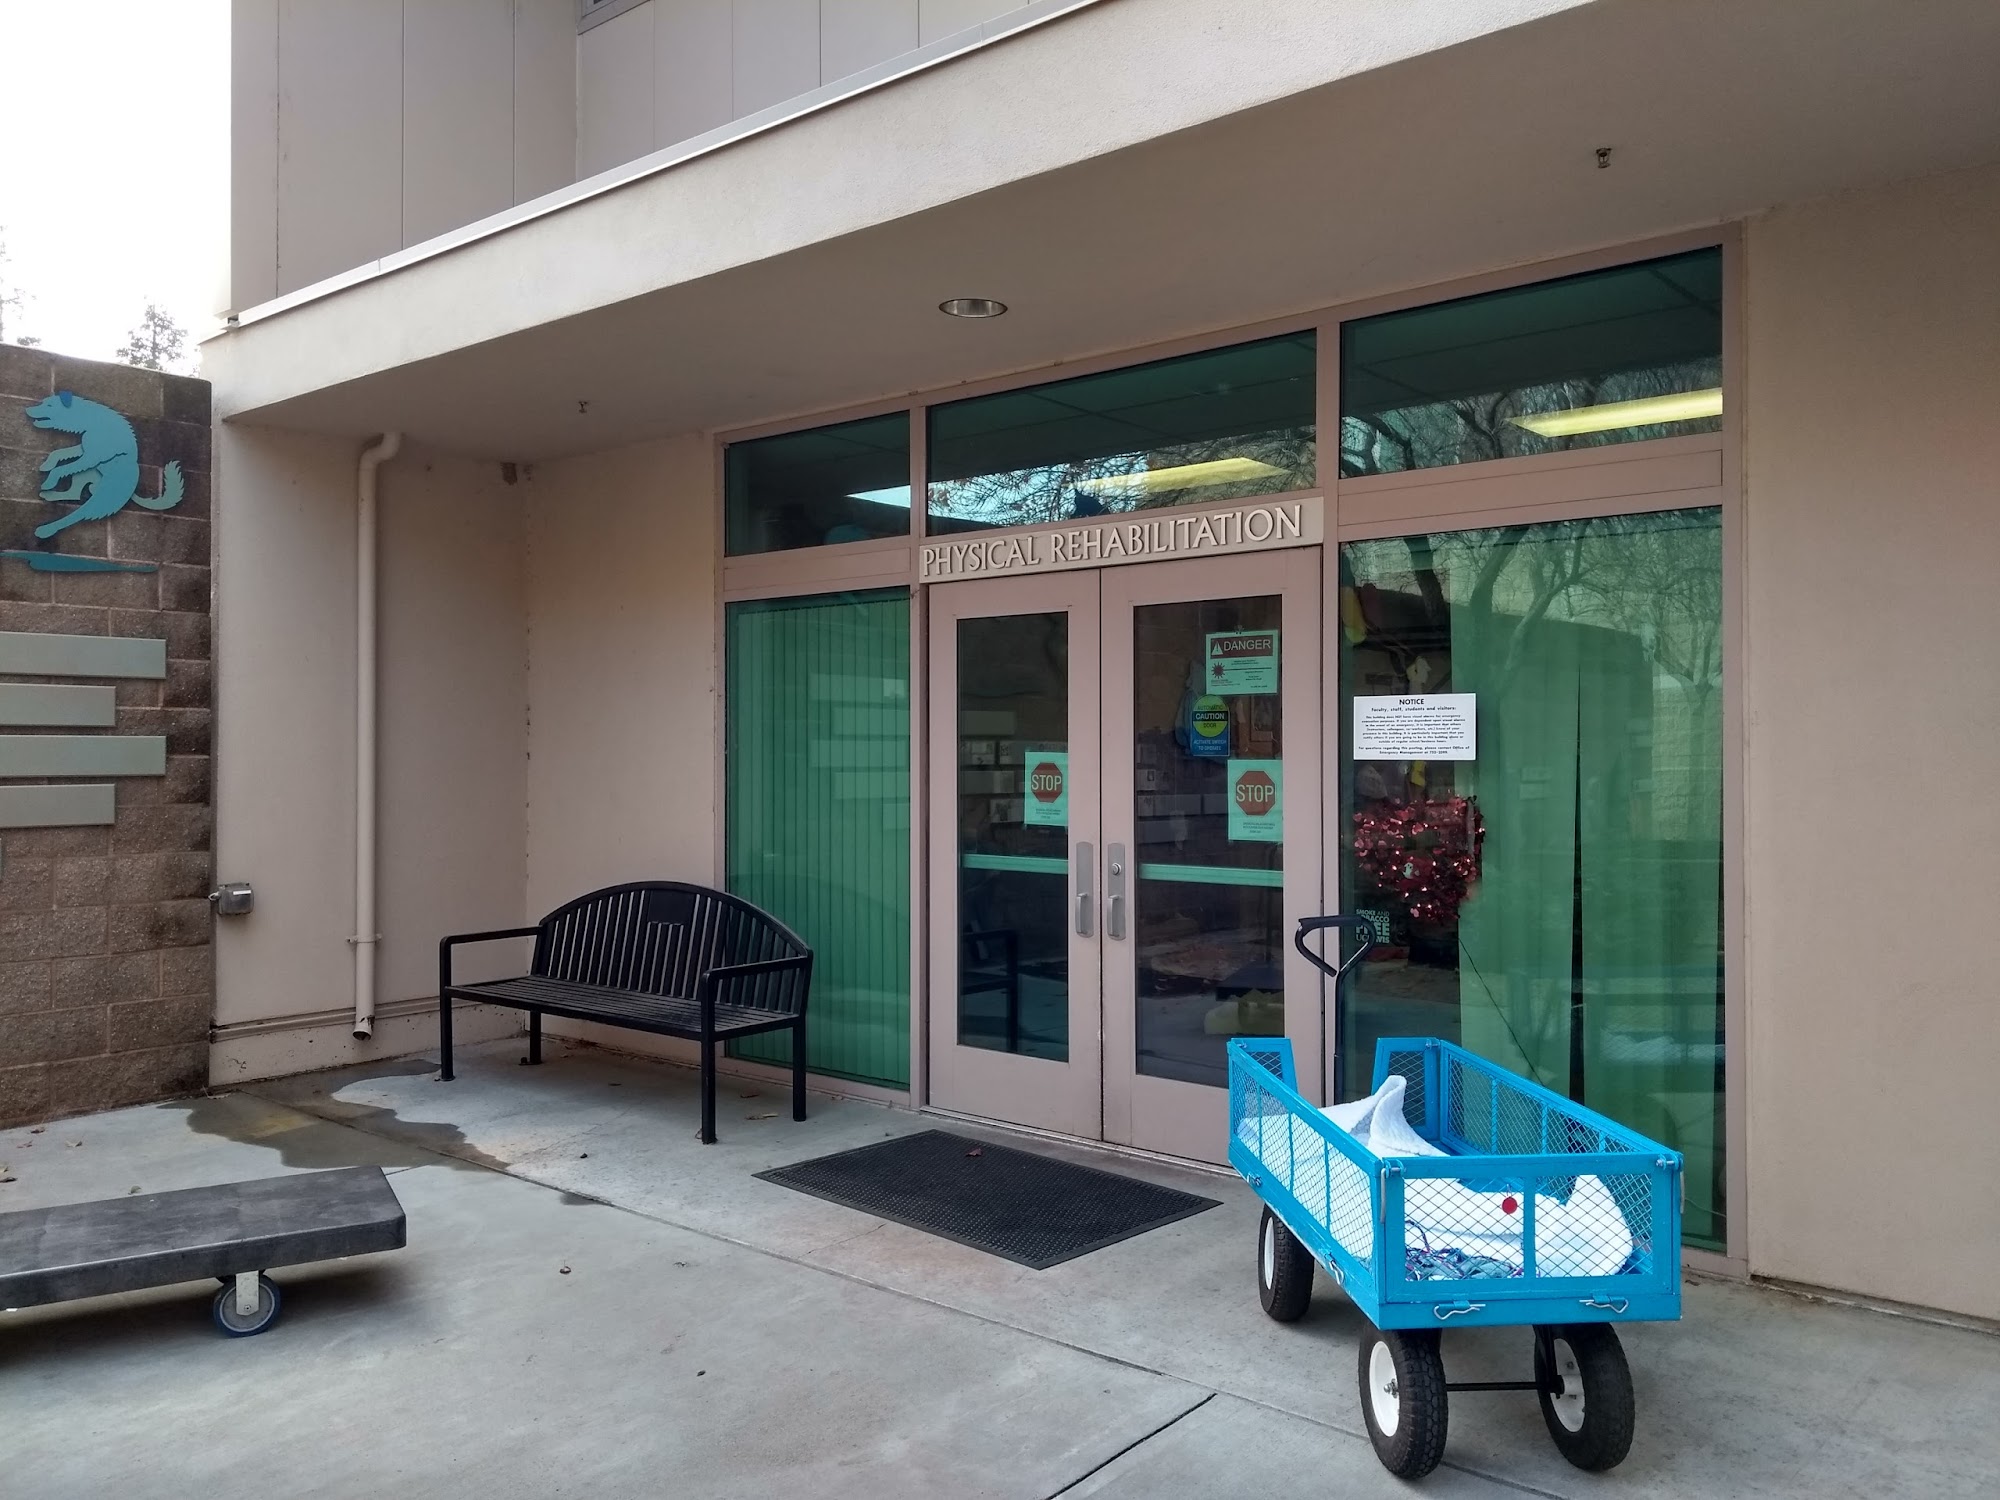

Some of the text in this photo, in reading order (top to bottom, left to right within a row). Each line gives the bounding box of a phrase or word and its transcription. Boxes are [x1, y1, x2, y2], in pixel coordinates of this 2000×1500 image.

[923, 505, 1302, 577] PHYSICAL REHABILITATION
[1224, 640, 1271, 651] DANGER
[1031, 774, 1062, 791] STOP
[1236, 785, 1274, 802] STOP
